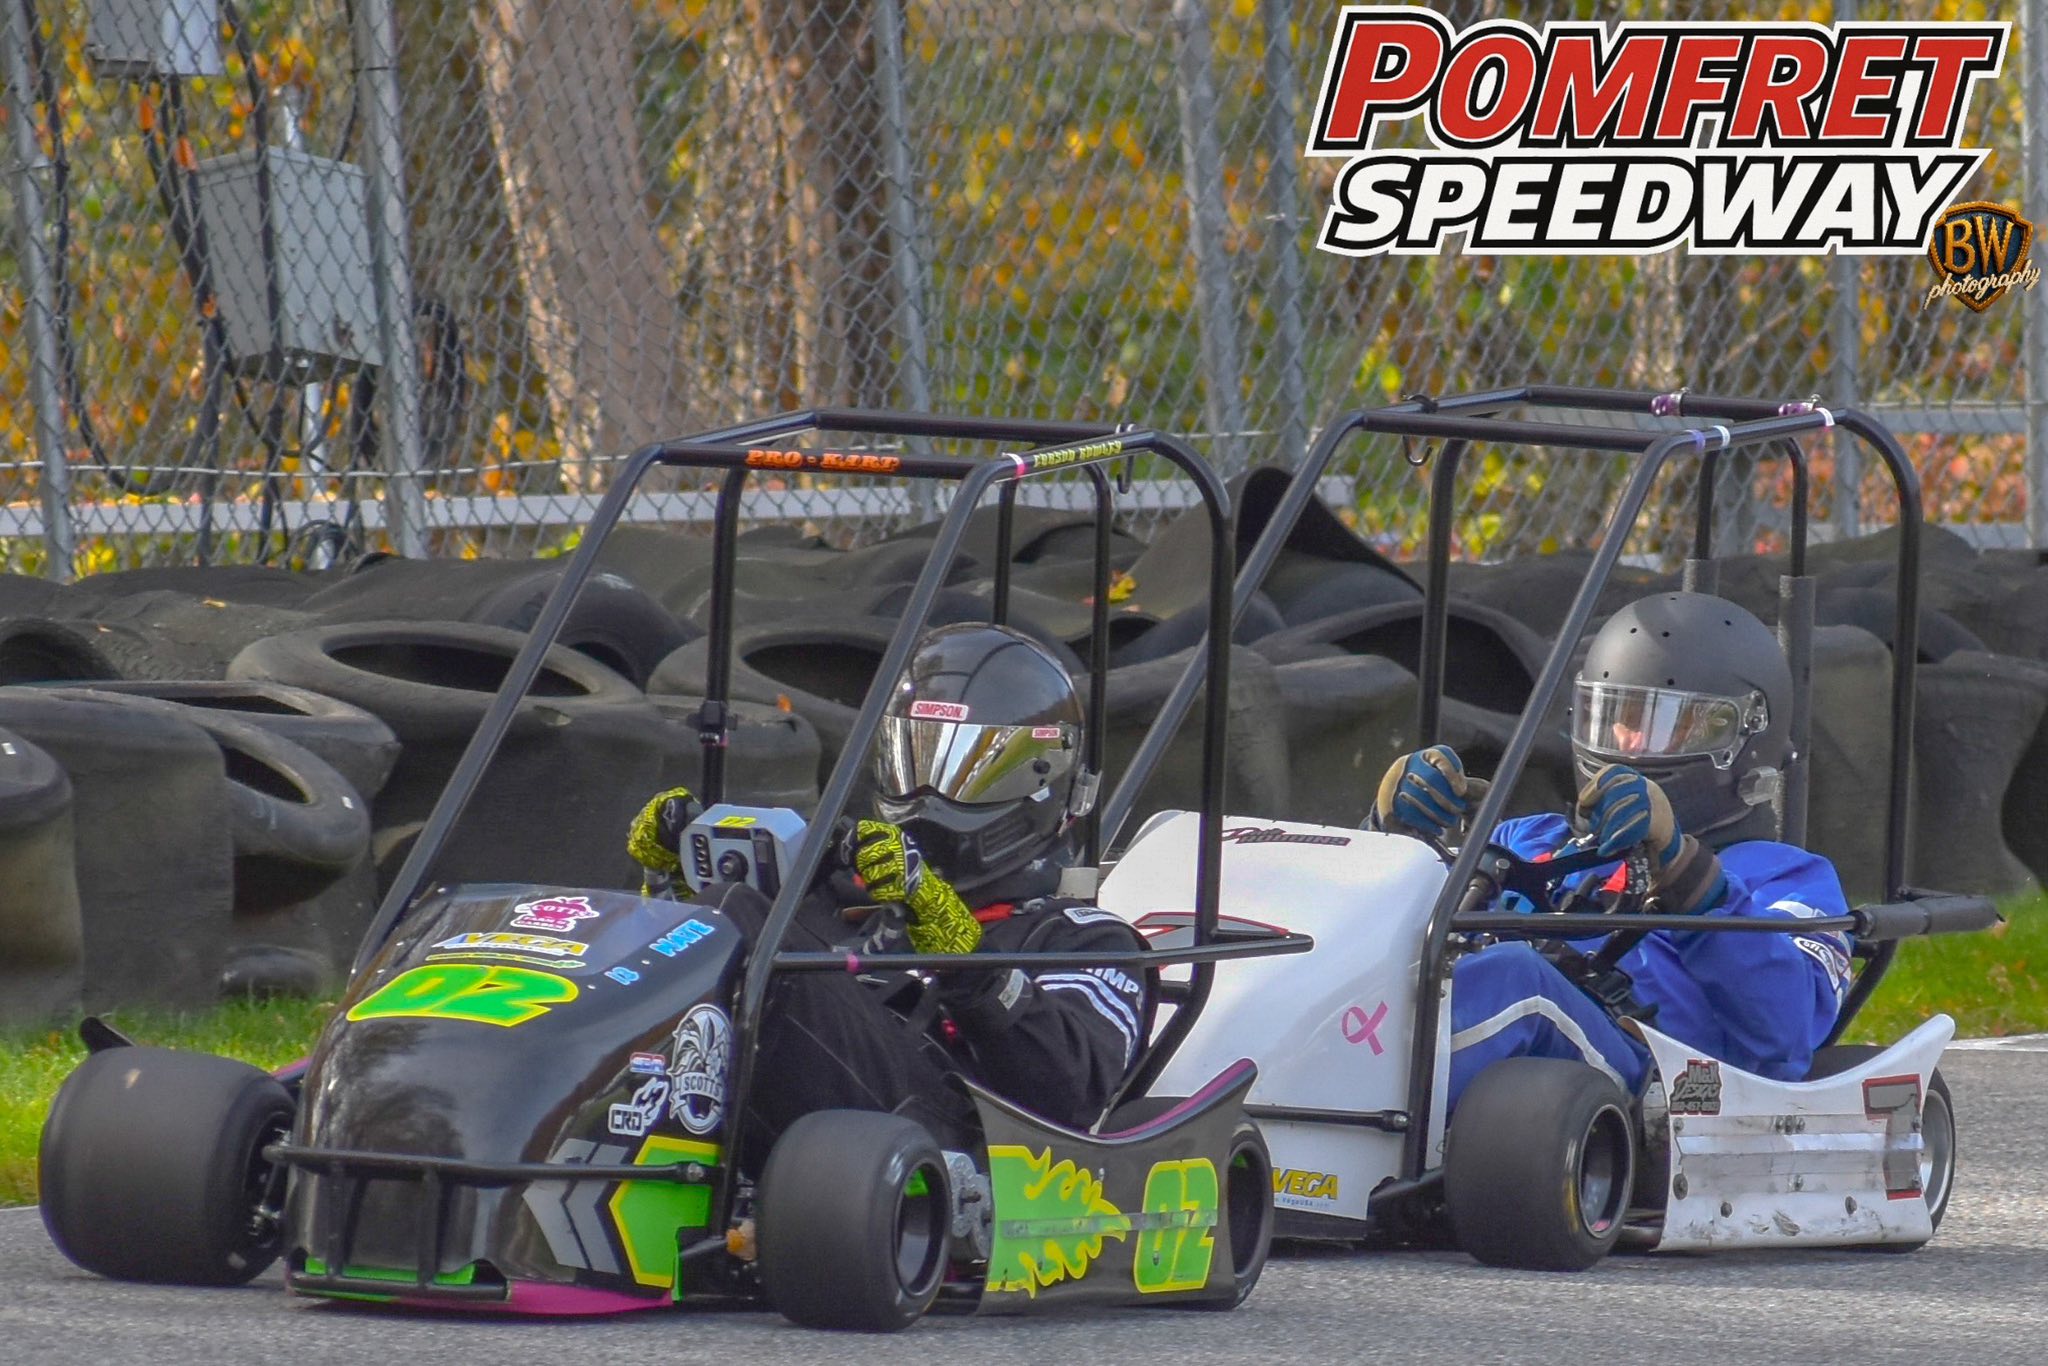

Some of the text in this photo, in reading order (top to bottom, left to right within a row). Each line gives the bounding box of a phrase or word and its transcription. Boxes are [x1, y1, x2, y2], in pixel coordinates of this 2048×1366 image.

[913, 702, 964, 719] SIMPSON
[464, 932, 589, 956] VEGA
[683, 1076, 722, 1096] SCOTTS
[1273, 1168, 1338, 1200] VEGA
